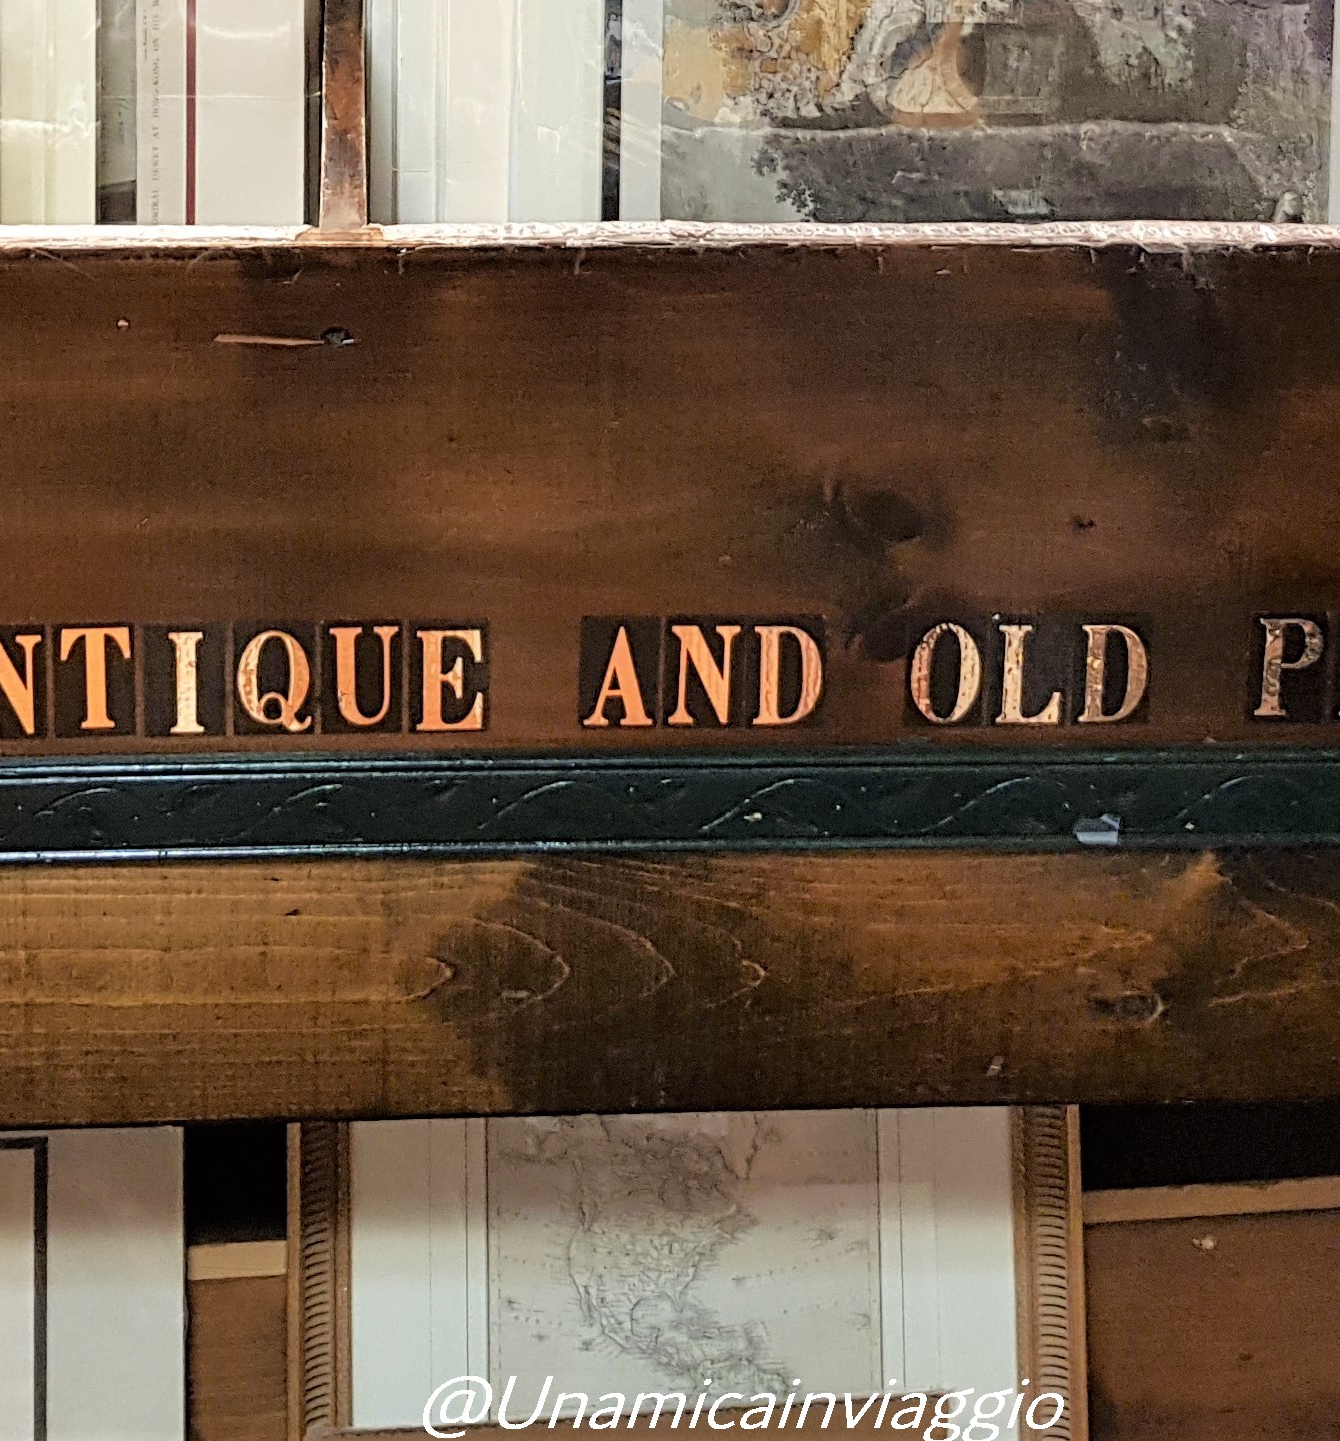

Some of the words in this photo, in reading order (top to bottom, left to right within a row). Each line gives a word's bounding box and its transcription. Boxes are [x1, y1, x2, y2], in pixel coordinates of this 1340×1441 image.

[151, 13, 160, 32] HIS
[151, 146, 160, 182] DEWEY
[151, 190, 160, 225] DMIRAL
[581, 623, 824, 727] AND
[910, 621, 1149, 726] OLD
